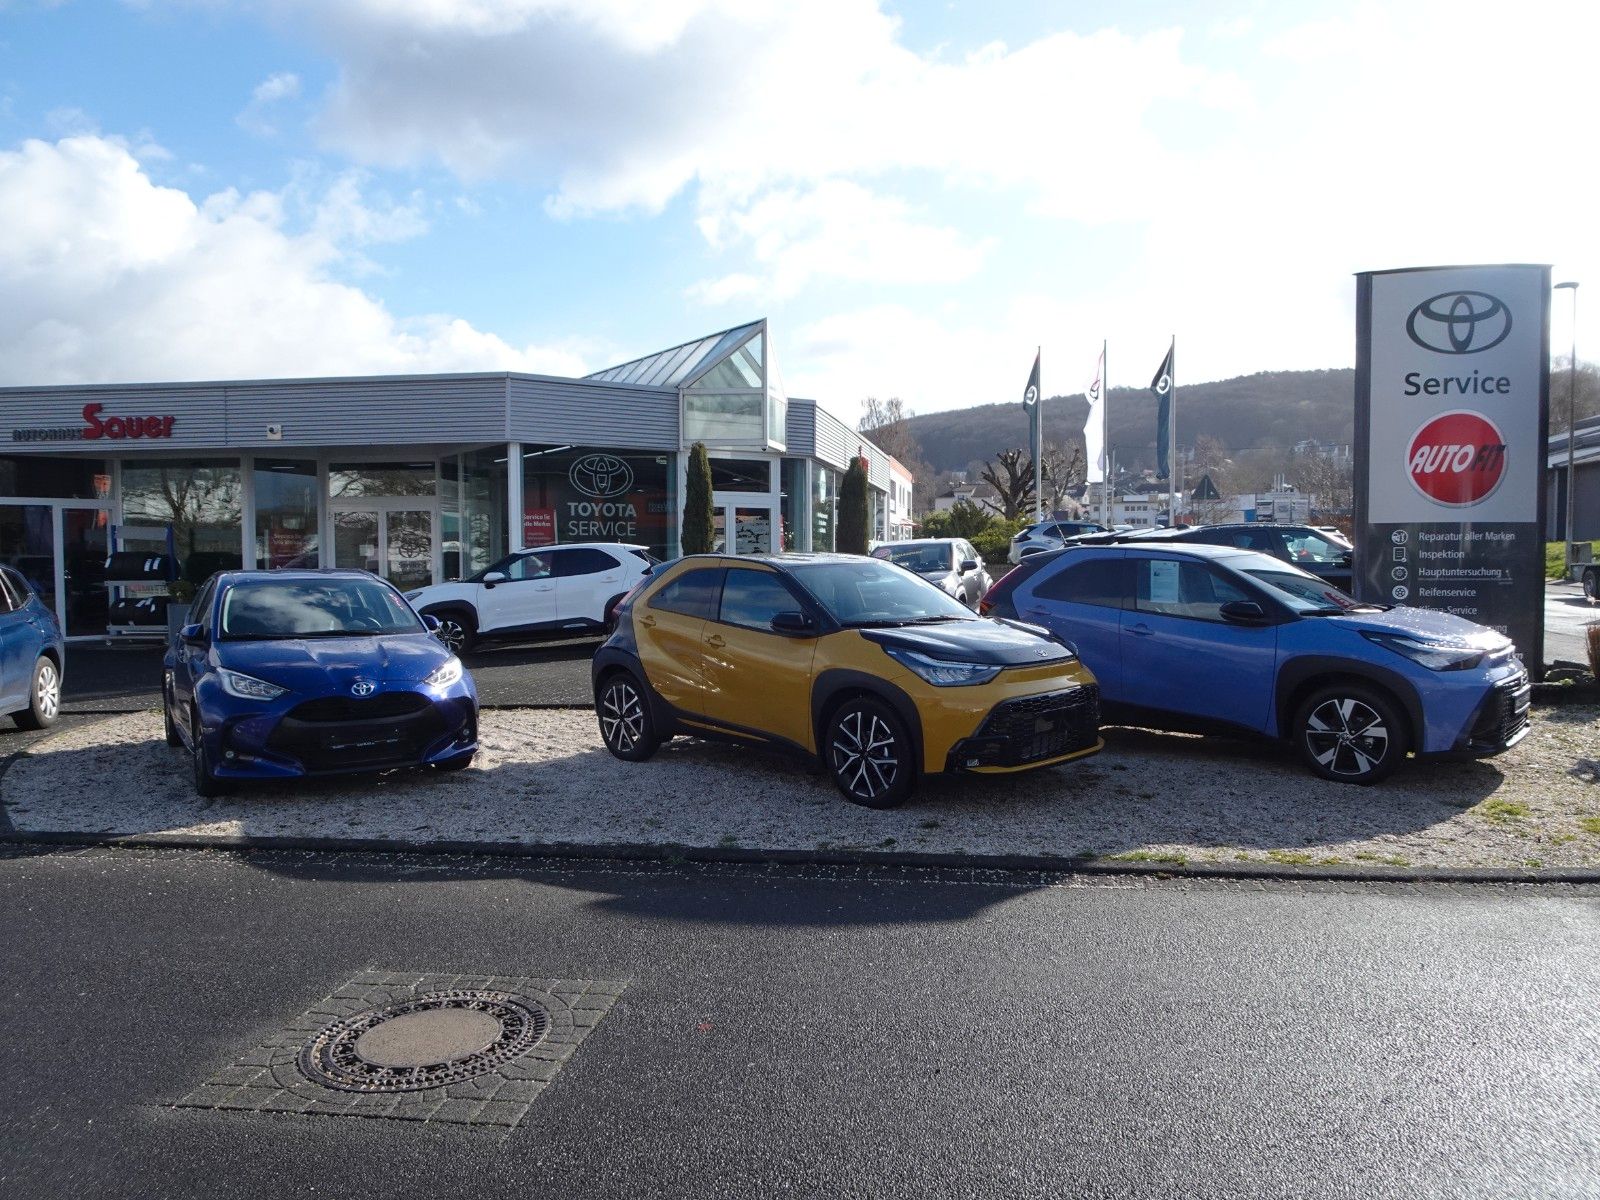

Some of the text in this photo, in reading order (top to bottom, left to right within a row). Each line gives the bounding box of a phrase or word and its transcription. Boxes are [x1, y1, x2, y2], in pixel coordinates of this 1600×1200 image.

[1404, 370, 1511, 396] Service
[82, 403, 176, 440] Sauer
[567, 502, 637, 517] TOYOTA
[568, 521, 637, 536] SERVICE
[1418, 531, 1515, 542] Reparatur aller Marken
[1419, 549, 1465, 560] Inspektion
[1418, 567, 1502, 578] Hauptuntersuchung
[1419, 587, 1477, 597] Reifenservice
